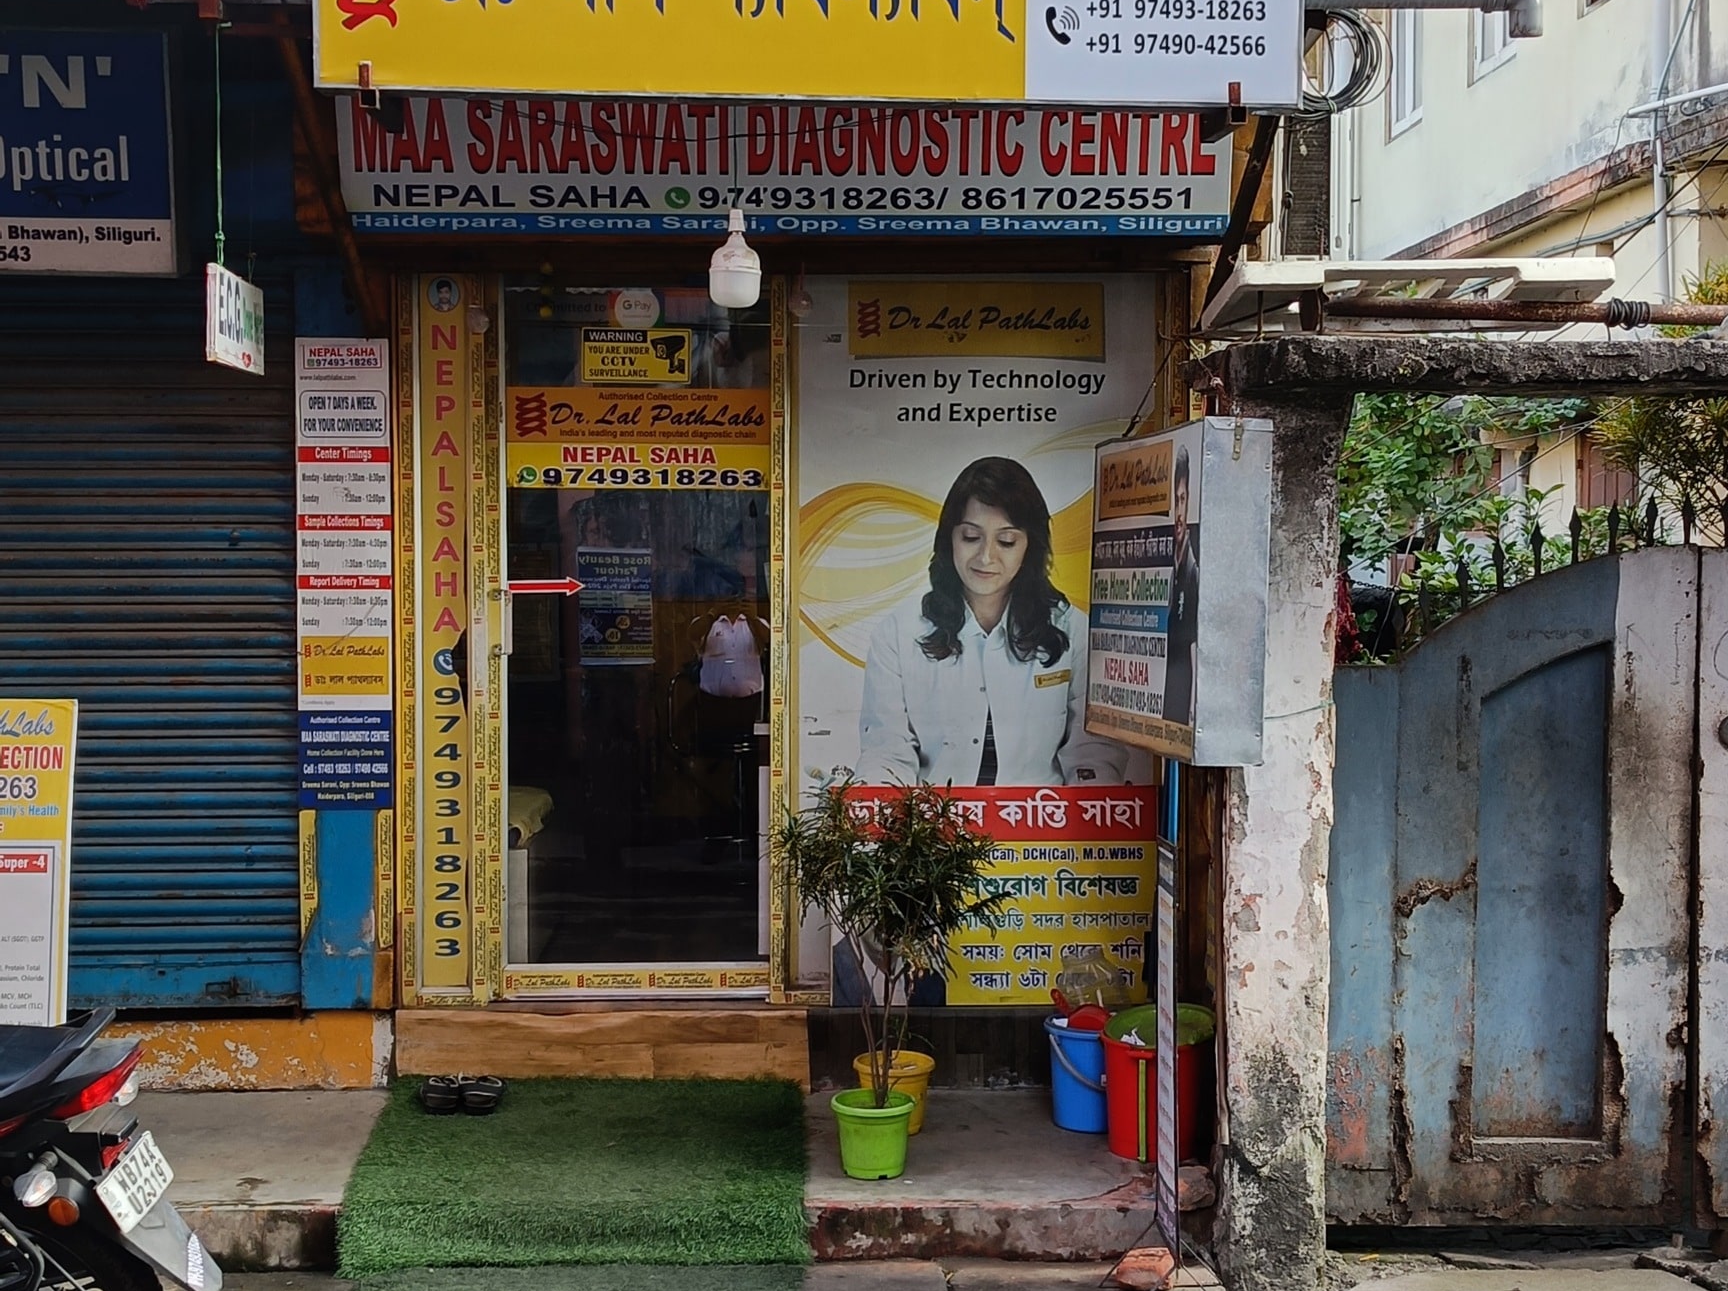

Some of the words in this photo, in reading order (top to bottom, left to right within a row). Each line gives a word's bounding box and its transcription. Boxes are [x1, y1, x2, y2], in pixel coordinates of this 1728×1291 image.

[1086, 33, 1122, 54] +91
[1134, 34, 1266, 56] 97490-42566
[353, 97, 454, 174] MAA
[466, 100, 730, 175] SARASWATI
[747, 105, 1025, 177] DIAGNOSTIC
[1040, 111, 1217, 177] CENTRE
[0, 135, 129, 190] ptical
[372, 183, 516, 209] NEPAL
[528, 184, 651, 209] SAHA
[961, 186, 1194, 210] 8617025551
[351, 214, 528, 231] Haiderpara,
[537, 215, 651, 230] Sreema
[661, 216, 767, 232] Sarai,
[776, 217, 846, 233] Opp.
[857, 217, 970, 232] Sreema
[981, 217, 1107, 233] Bhawan,
[1118, 217, 1223, 233] Siliguri
[8, 225, 89, 244] Bhawan),
[95, 227, 161, 245] Siliguri.
[634, 300, 652, 313] Pay
[887, 305, 922, 331] Dr
[925, 306, 971, 331] Lal
[977, 306, 1092, 331] PathLabs
[589, 332, 644, 342] WARNING
[309, 348, 343, 357] NEPAL
[346, 348, 375, 356] SAHA
[587, 345, 602, 355] YOU
[603, 346, 621, 355] ARE
[623, 346, 650, 355] UNDER
[316, 358, 378, 366] 97493-18263
[601, 356, 636, 367] CCTV
[589, 368, 649, 378] SURVEILLANCE
[849, 369, 926, 389] Driven
[933, 369, 961, 394] by
[967, 369, 1106, 395] Technology
[309, 396, 326, 410] OPEN
[327, 396, 331, 410] 7
[333, 396, 349, 410] DAYS
[351, 396, 355, 410] A
[598, 392, 644, 401] Authorised
[646, 392, 688, 402] Collection
[690, 394, 719, 402] Centre
[549, 402, 590, 426] Dr.
[594, 403, 642, 426] Lal
[650, 403, 766, 427] PathLabs
[896, 403, 941, 422] and
[949, 403, 1057, 427] Expertise
[304, 418, 316, 431] FOR
[318, 418, 335, 431] YOUR
[337, 419, 383, 431] CONVENIENCE
[559, 429, 586, 438] India's
[588, 429, 618, 439] leading
[619, 429, 635, 438] and
[636, 430, 657, 438] most
[658, 430, 690, 440] reputed
[691, 429, 732, 440] diagnostic
[734, 430, 756, 439] chain
[315, 447, 340, 459] Center
[342, 447, 372, 461] Timings
[562, 446, 641, 464] NEPAL
[650, 446, 717, 464] SAHA
[542, 468, 762, 487] 9749318263
[360, 516, 383, 529] Timings
[310, 577, 330, 587] Report
[332, 577, 357, 588] Delivery
[358, 577, 379, 588] Timing
[1094, 572, 1108, 600] Free
[1110, 571, 1129, 600] Home
[1131, 571, 1168, 601] Collection
[329, 645, 344, 656] Lal
[346, 645, 385, 657] PathLabs
[1104, 657, 1126, 683] NEPAL
[1128, 660, 1149, 686] SAHA
[29, 805, 59, 816] Health
[996, 788, 1069, 830] কান্তি
[1077, 797, 1144, 830] সাহা
[434, 688, 462, 958] 9749318263
[1023, 848, 1079, 862] DCH(Cal),
[1083, 848, 1144, 860] M.O.WBHS
[1054, 867, 1140, 897] বিশেষজ্ঞ
[1032, 913, 1065, 927] সদর
[1071, 913, 1150, 928] হাসপাতাল
[1013, 945, 1053, 961] সোম
[1110, 938, 1144, 959] শনি
[970, 973, 1011, 989] সন্ধ্যা
